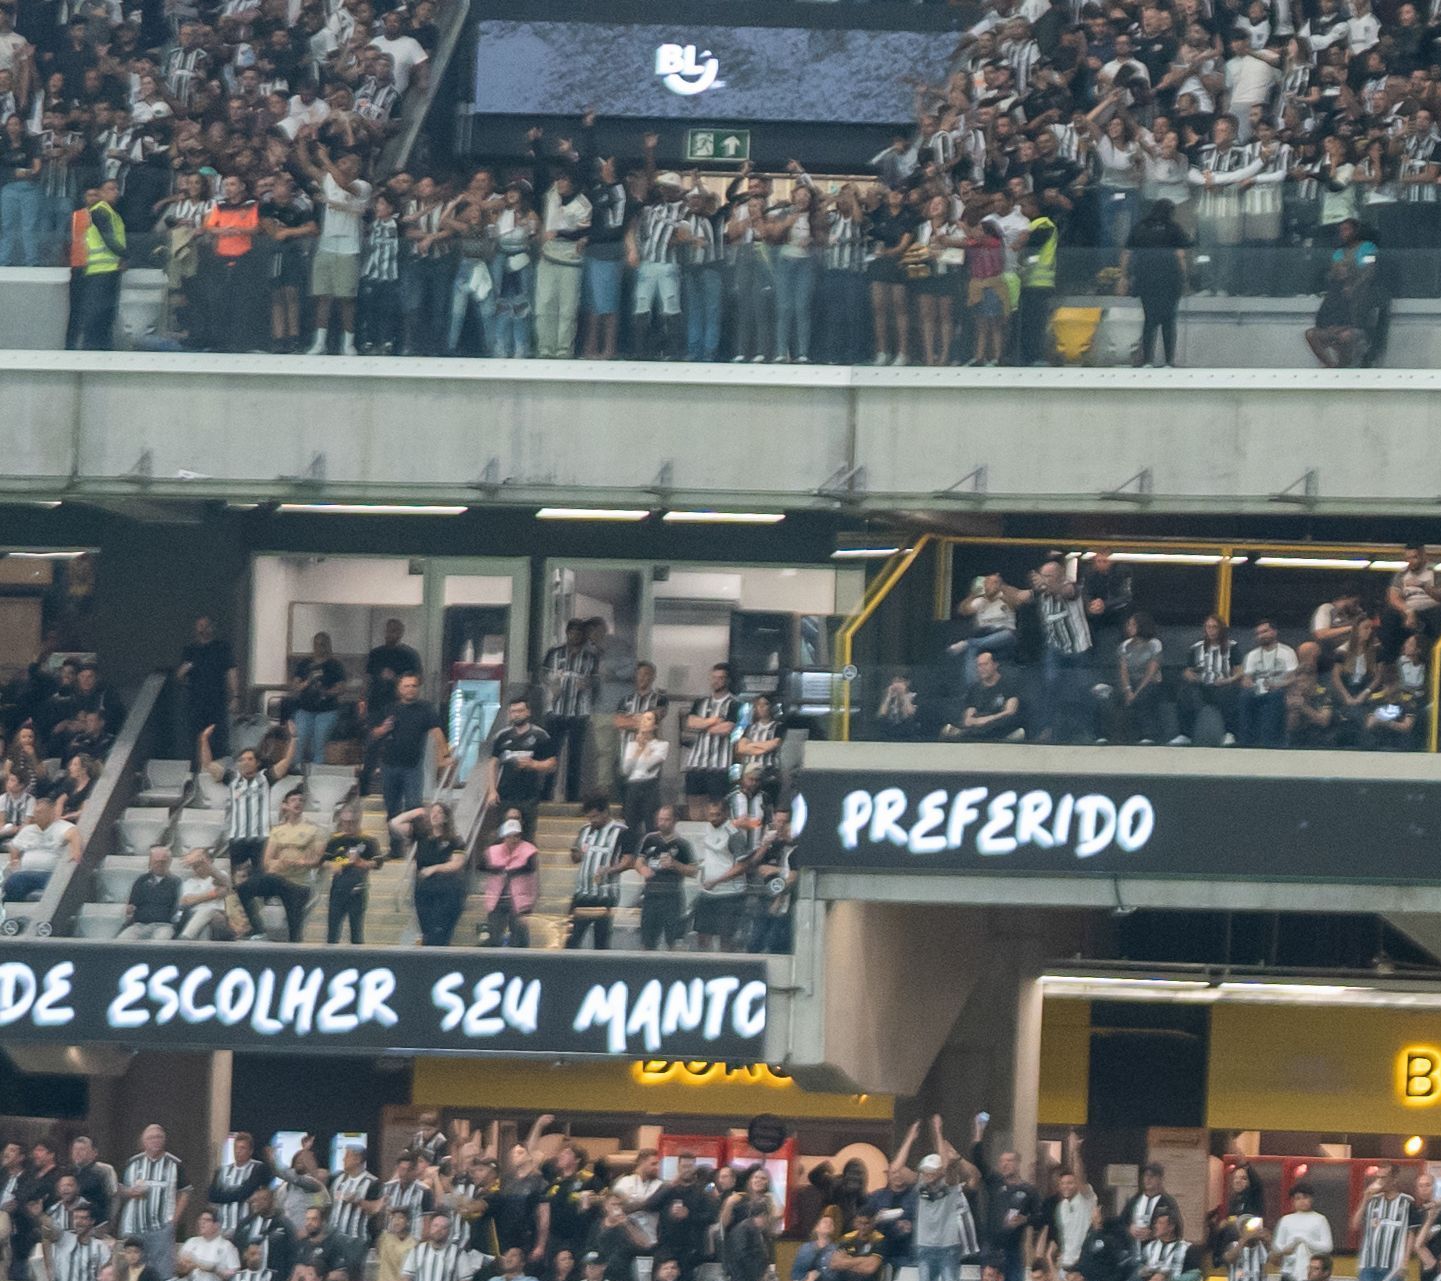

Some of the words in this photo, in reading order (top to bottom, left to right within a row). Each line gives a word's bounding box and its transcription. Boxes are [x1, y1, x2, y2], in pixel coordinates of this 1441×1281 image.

[838, 786, 1154, 857] PREFERIDO
[0, 961, 75, 1026] DE
[108, 963, 398, 1033] ESCOLHER
[432, 972, 541, 1035] SEU
